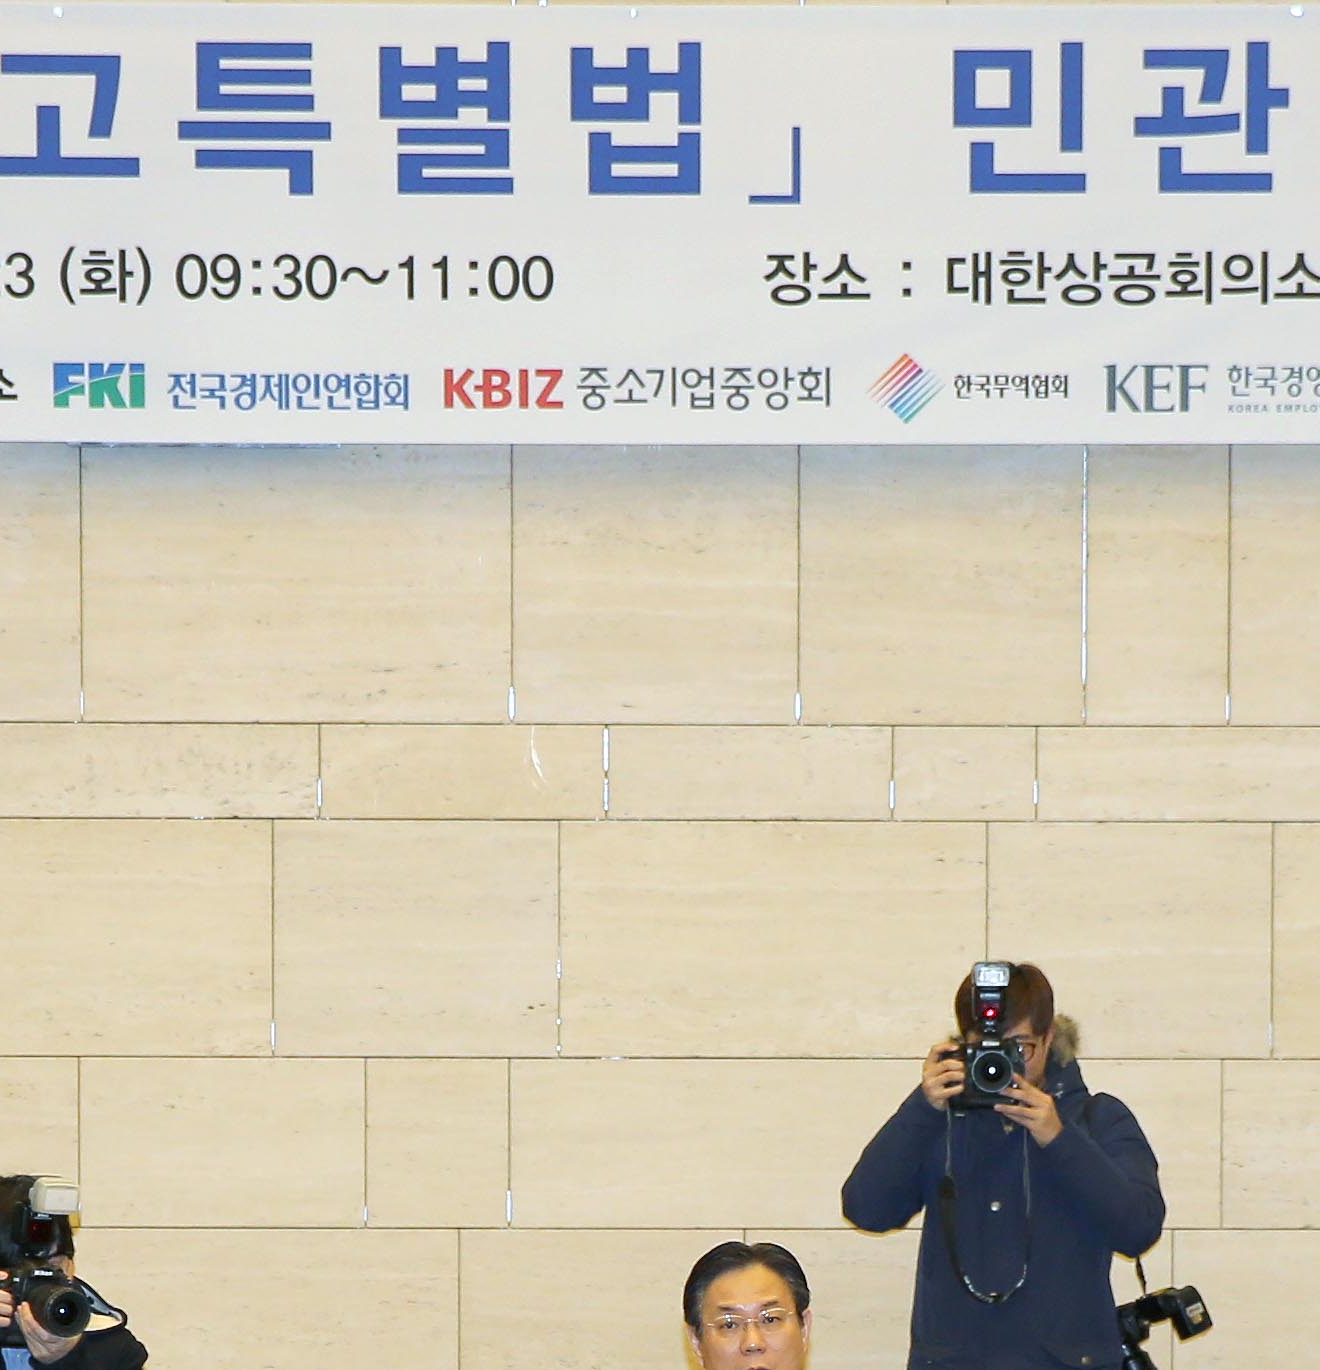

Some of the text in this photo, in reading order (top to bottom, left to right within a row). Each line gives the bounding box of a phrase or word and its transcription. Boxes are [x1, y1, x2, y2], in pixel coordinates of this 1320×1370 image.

[61, 247, 153, 307] (화)
[764, 252, 873, 307] 장소
[902, 261, 913, 298] :
[54, 363, 146, 410] FKI
[168, 373, 410, 412] 전국경제인연합회
[444, 368, 565, 411] KBIZ
[577, 366, 833, 413] 중소기업중앙회
[954, 375, 1069, 401] 한국무역협회
[1104, 364, 1210, 413] KEF
[1228, 404, 1269, 414] KOREA
